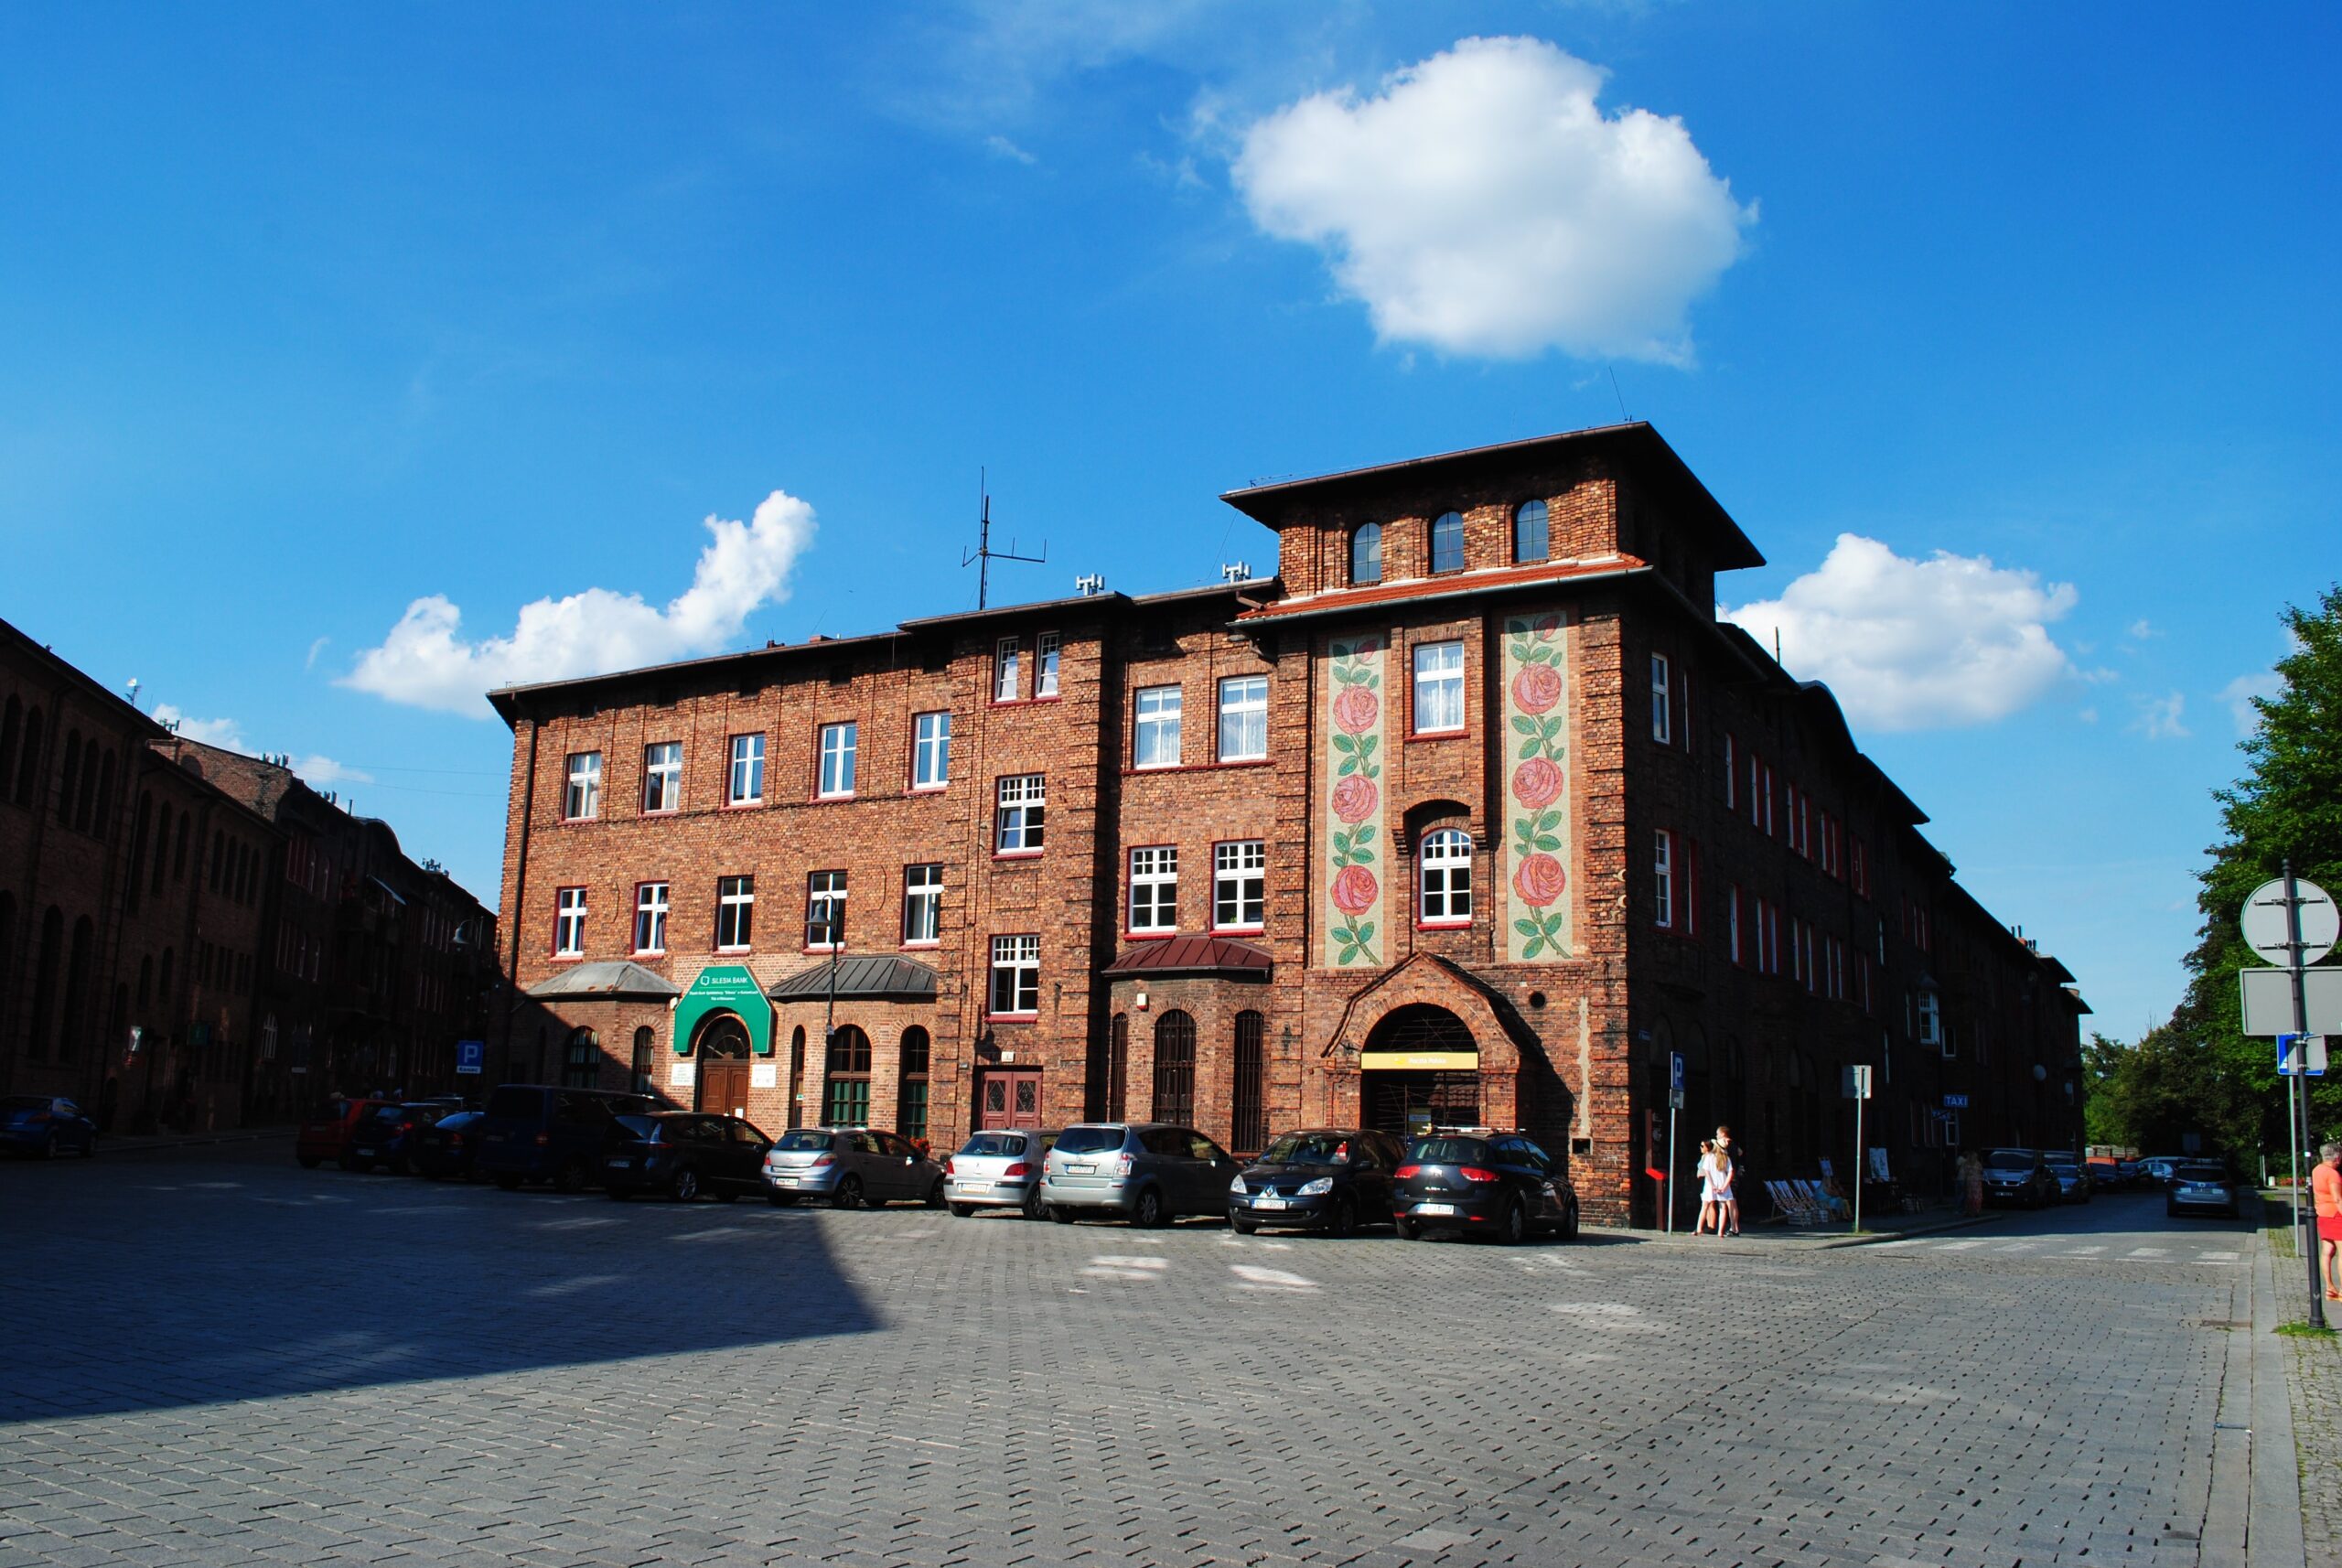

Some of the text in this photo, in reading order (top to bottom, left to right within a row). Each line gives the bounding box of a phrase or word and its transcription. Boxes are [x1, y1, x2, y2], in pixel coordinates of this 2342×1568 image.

[465, 1046, 478, 1063] P
[1674, 1057, 1683, 1085] P
[1946, 1096, 1968, 1106] TAXI
